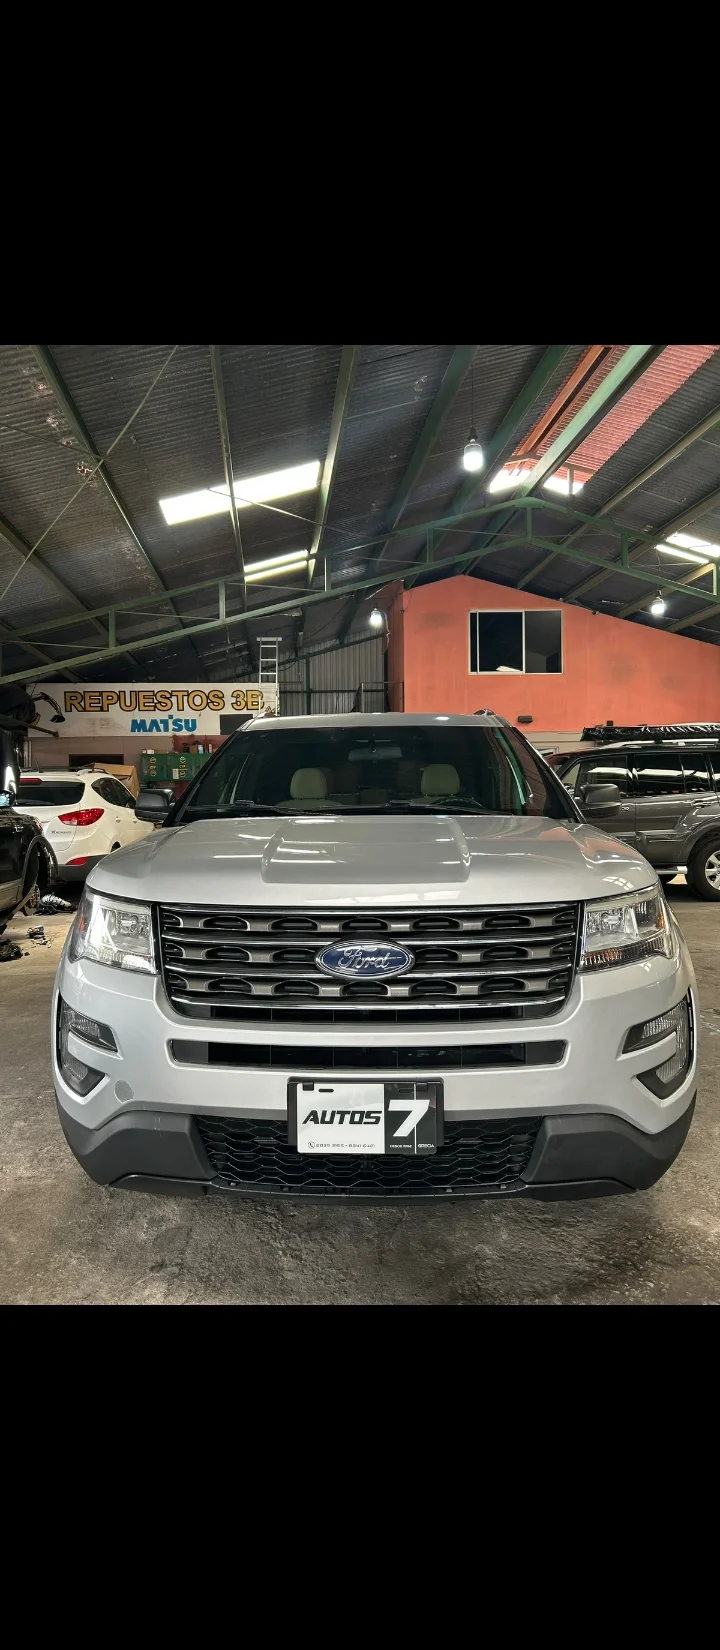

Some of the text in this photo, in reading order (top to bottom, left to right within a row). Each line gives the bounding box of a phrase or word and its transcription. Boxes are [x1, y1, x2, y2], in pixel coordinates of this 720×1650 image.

[63, 689, 265, 712] REPUESTOS 3B
[130, 714, 197, 732] MATSU
[337, 946, 403, 969] Ford
[302, 1099, 430, 1137] AUTOS 7
